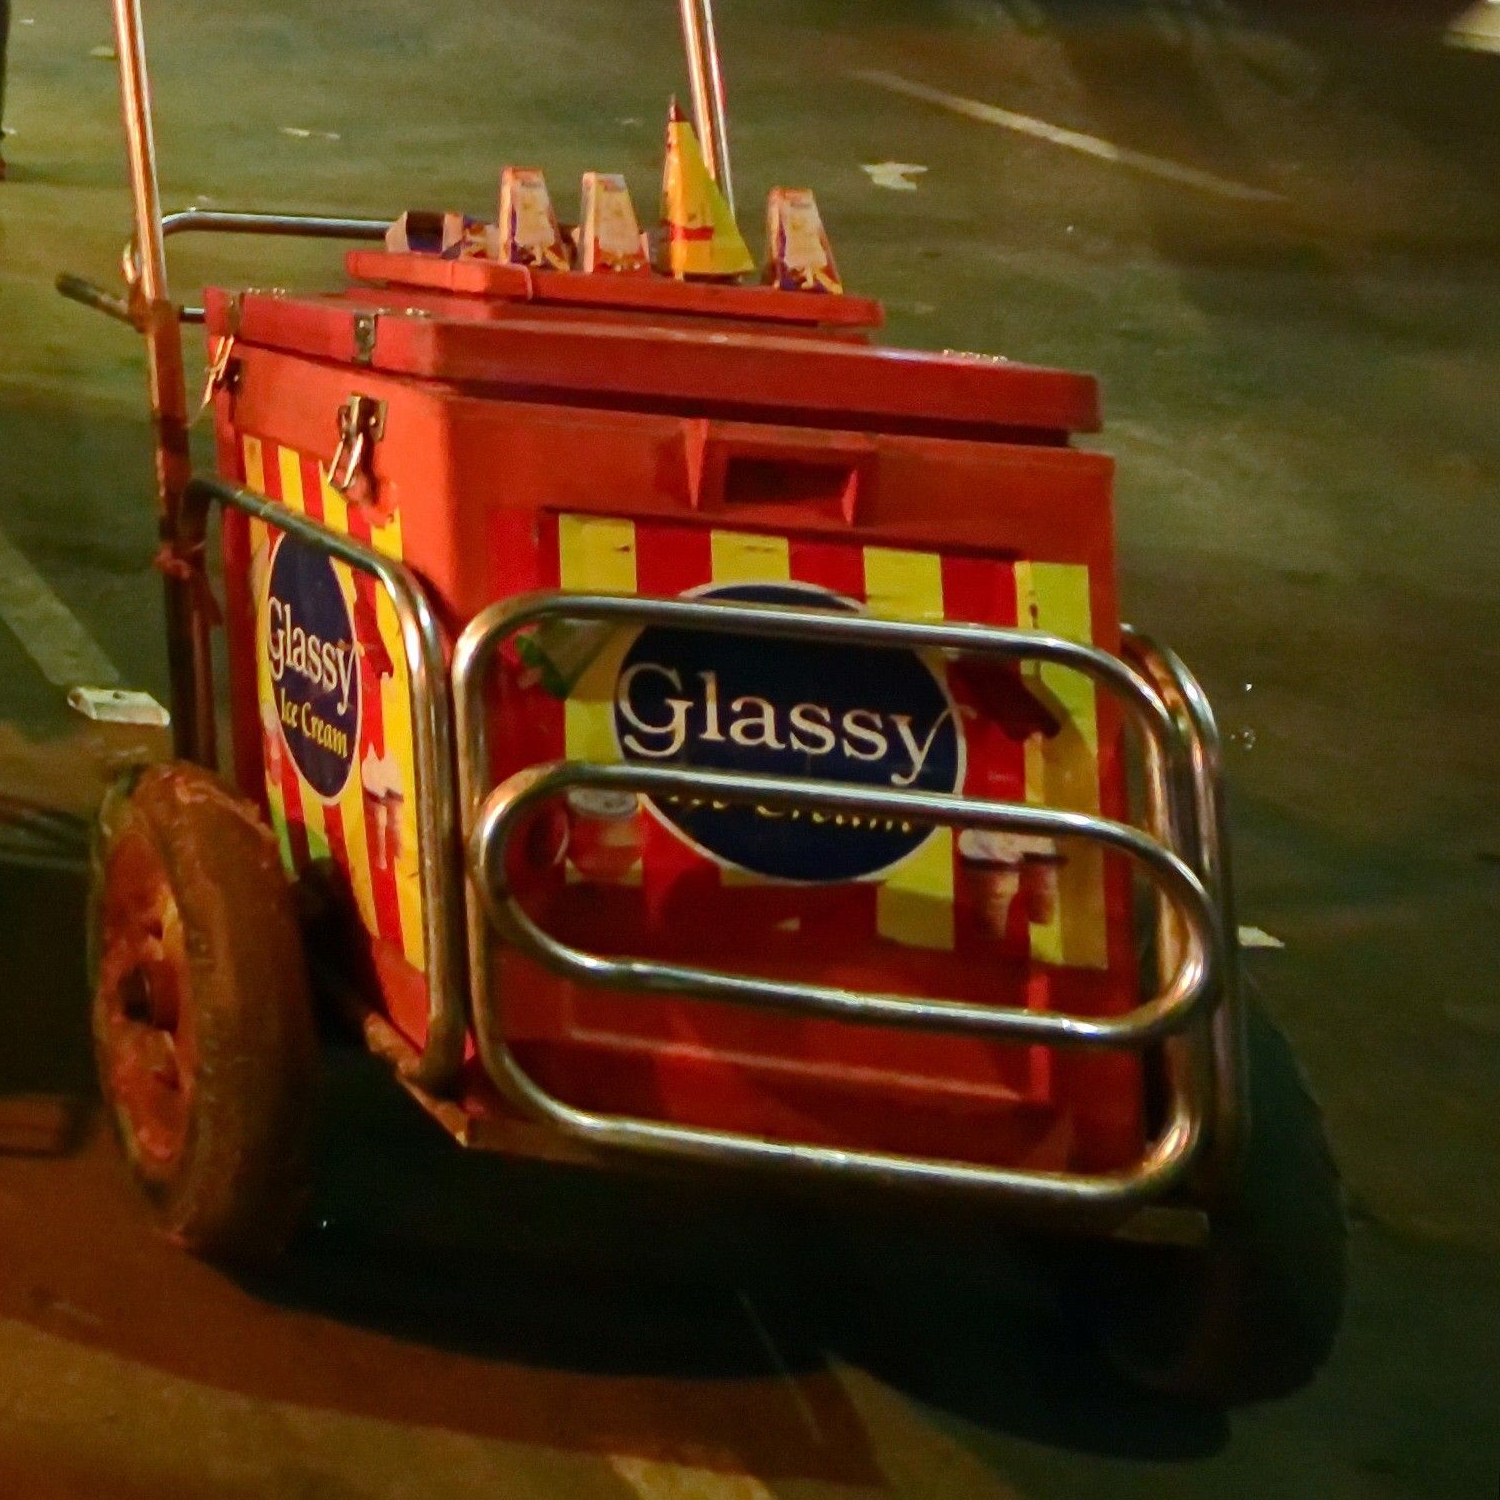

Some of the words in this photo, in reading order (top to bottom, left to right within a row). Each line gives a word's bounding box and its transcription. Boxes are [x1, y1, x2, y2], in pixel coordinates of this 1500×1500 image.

[268, 596, 360, 716] Glassy
[280, 687, 298, 729] Ice
[301, 701, 349, 760] Cream
[619, 663, 977, 785] Glassy
